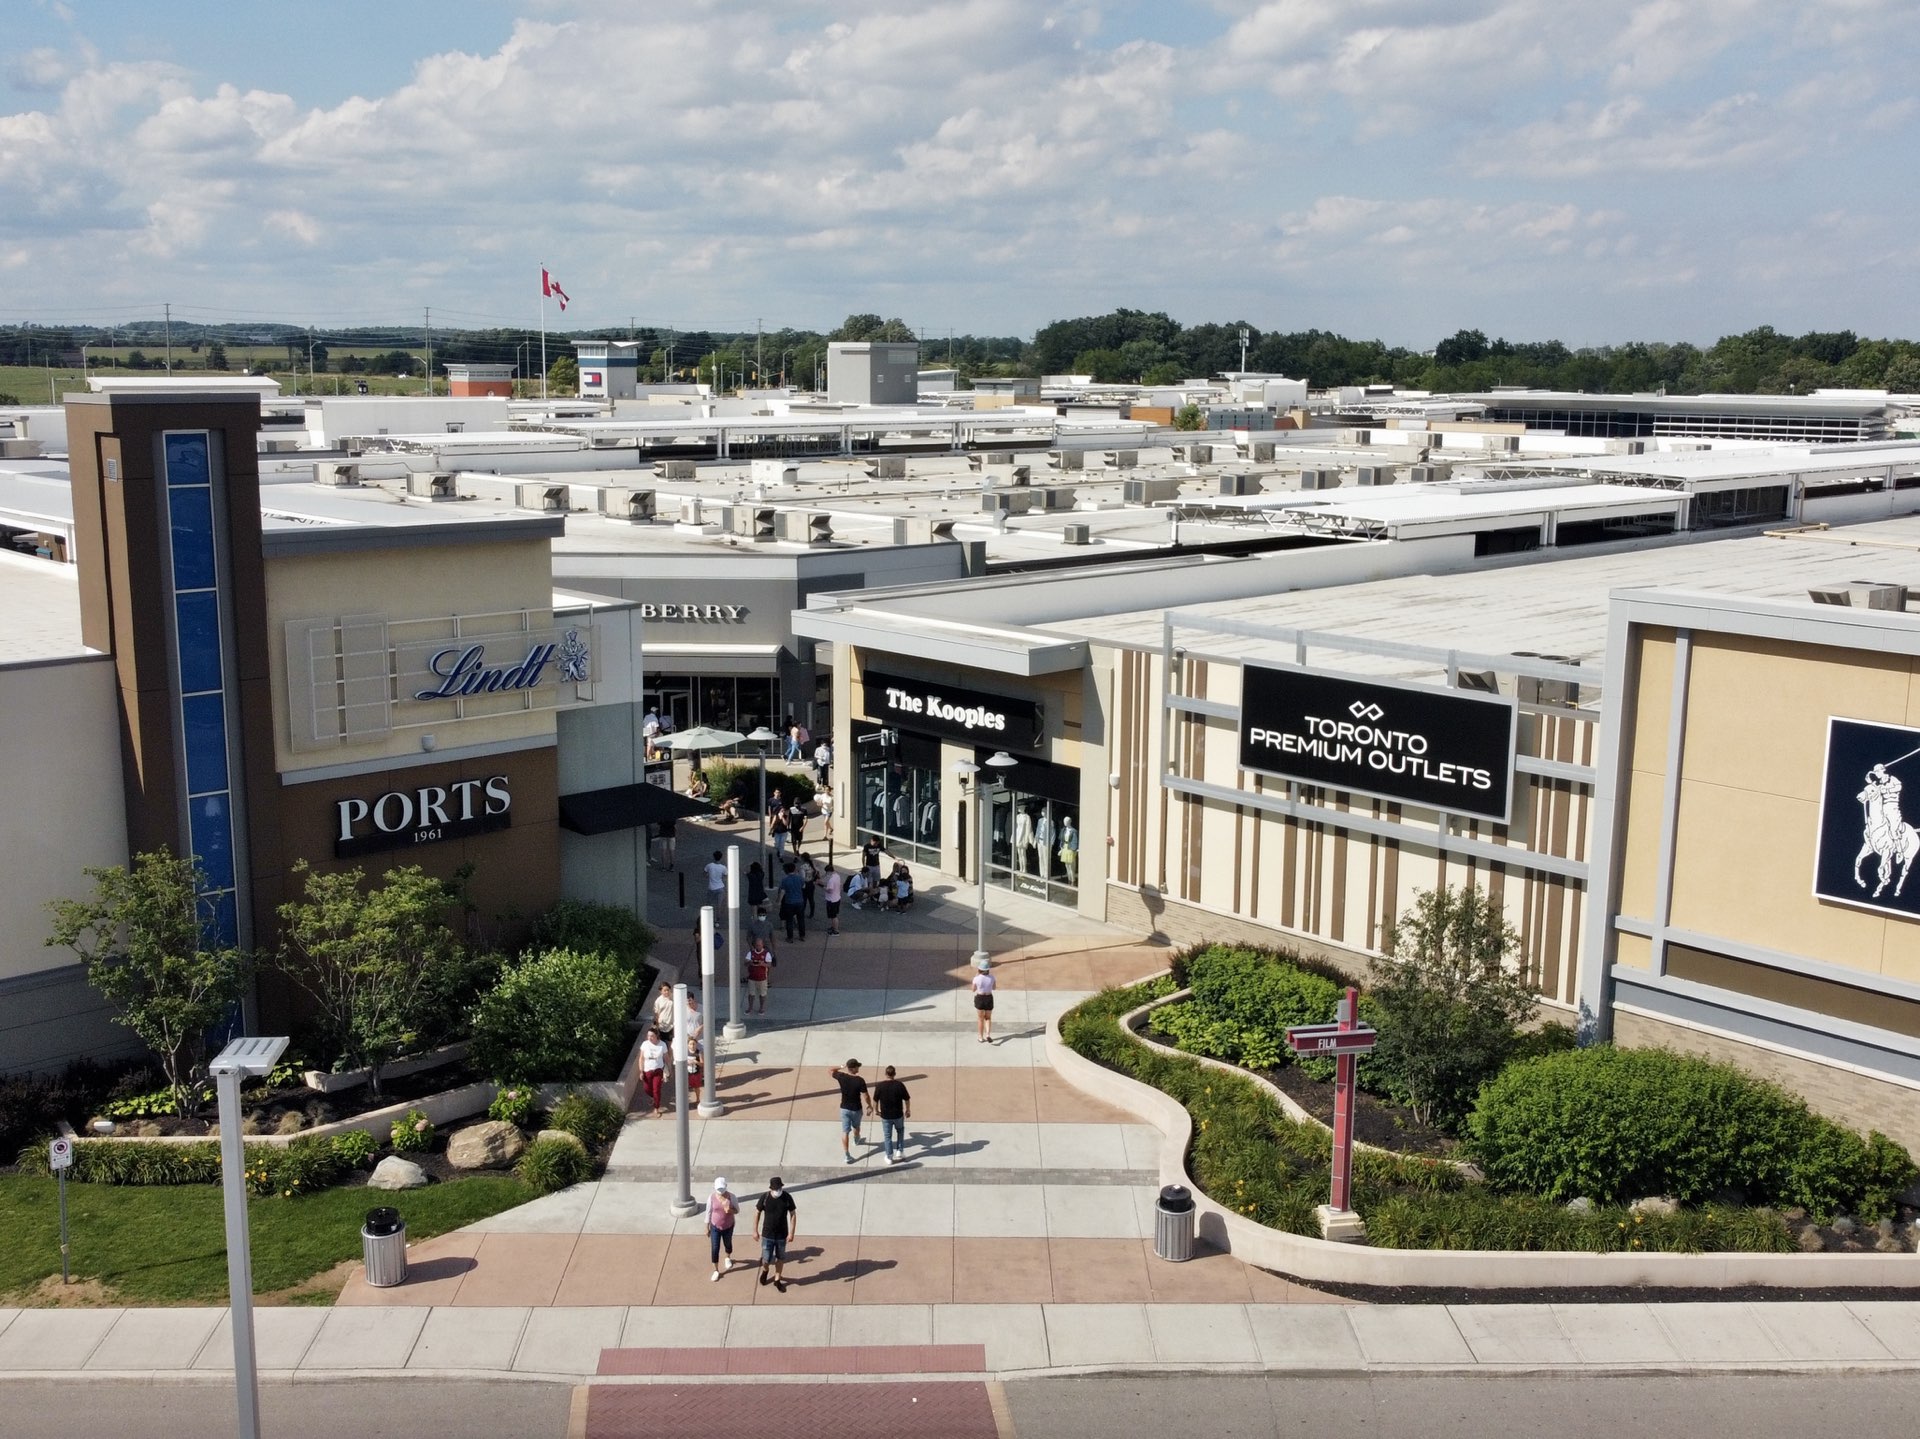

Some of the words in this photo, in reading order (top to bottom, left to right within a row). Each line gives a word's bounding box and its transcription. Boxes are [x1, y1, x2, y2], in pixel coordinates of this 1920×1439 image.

[641, 603, 745, 619] BERRY
[414, 644, 556, 700] Lindt
[886, 687, 923, 713] The
[926, 695, 1005, 731] Kooples
[1304, 715, 1428, 755] TORONTO
[1250, 727, 1362, 766] PREMIUM
[1368, 750, 1492, 790] OUTLETS
[338, 776, 511, 841] PORTS
[414, 828, 442, 843] 1961
[1318, 1038, 1337, 1049] FILM
